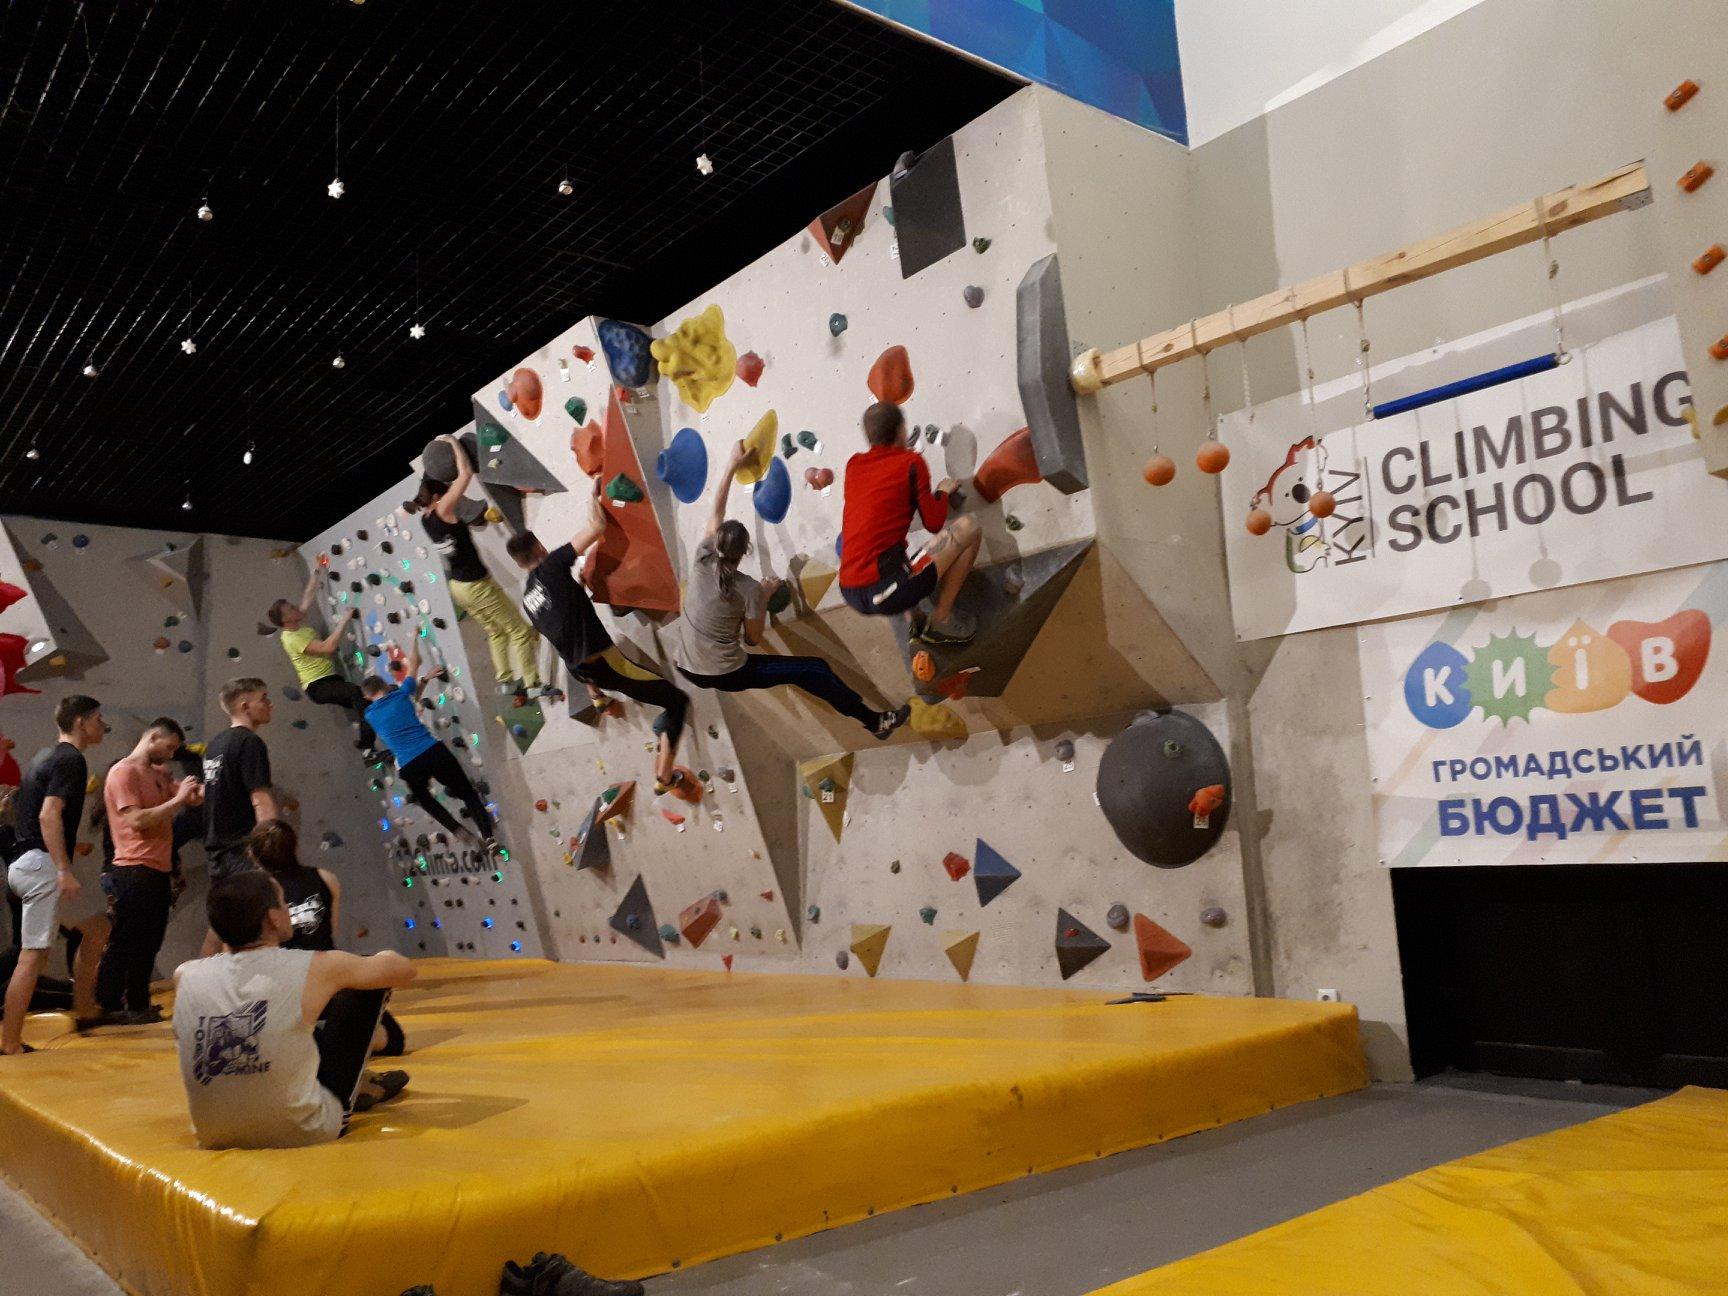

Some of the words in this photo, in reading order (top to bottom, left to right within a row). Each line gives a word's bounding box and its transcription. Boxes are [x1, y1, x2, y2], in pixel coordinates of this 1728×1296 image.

[1381, 370, 1694, 495] CLIMBING
[1328, 469, 1367, 566] KYIV
[1388, 454, 1654, 553] SCHOOL
[1422, 635, 1679, 708] КИЇВ
[1432, 733, 1704, 783] ГРОМАДСЬКИЙ
[1437, 785, 1707, 841] БЮДЖЕТ
